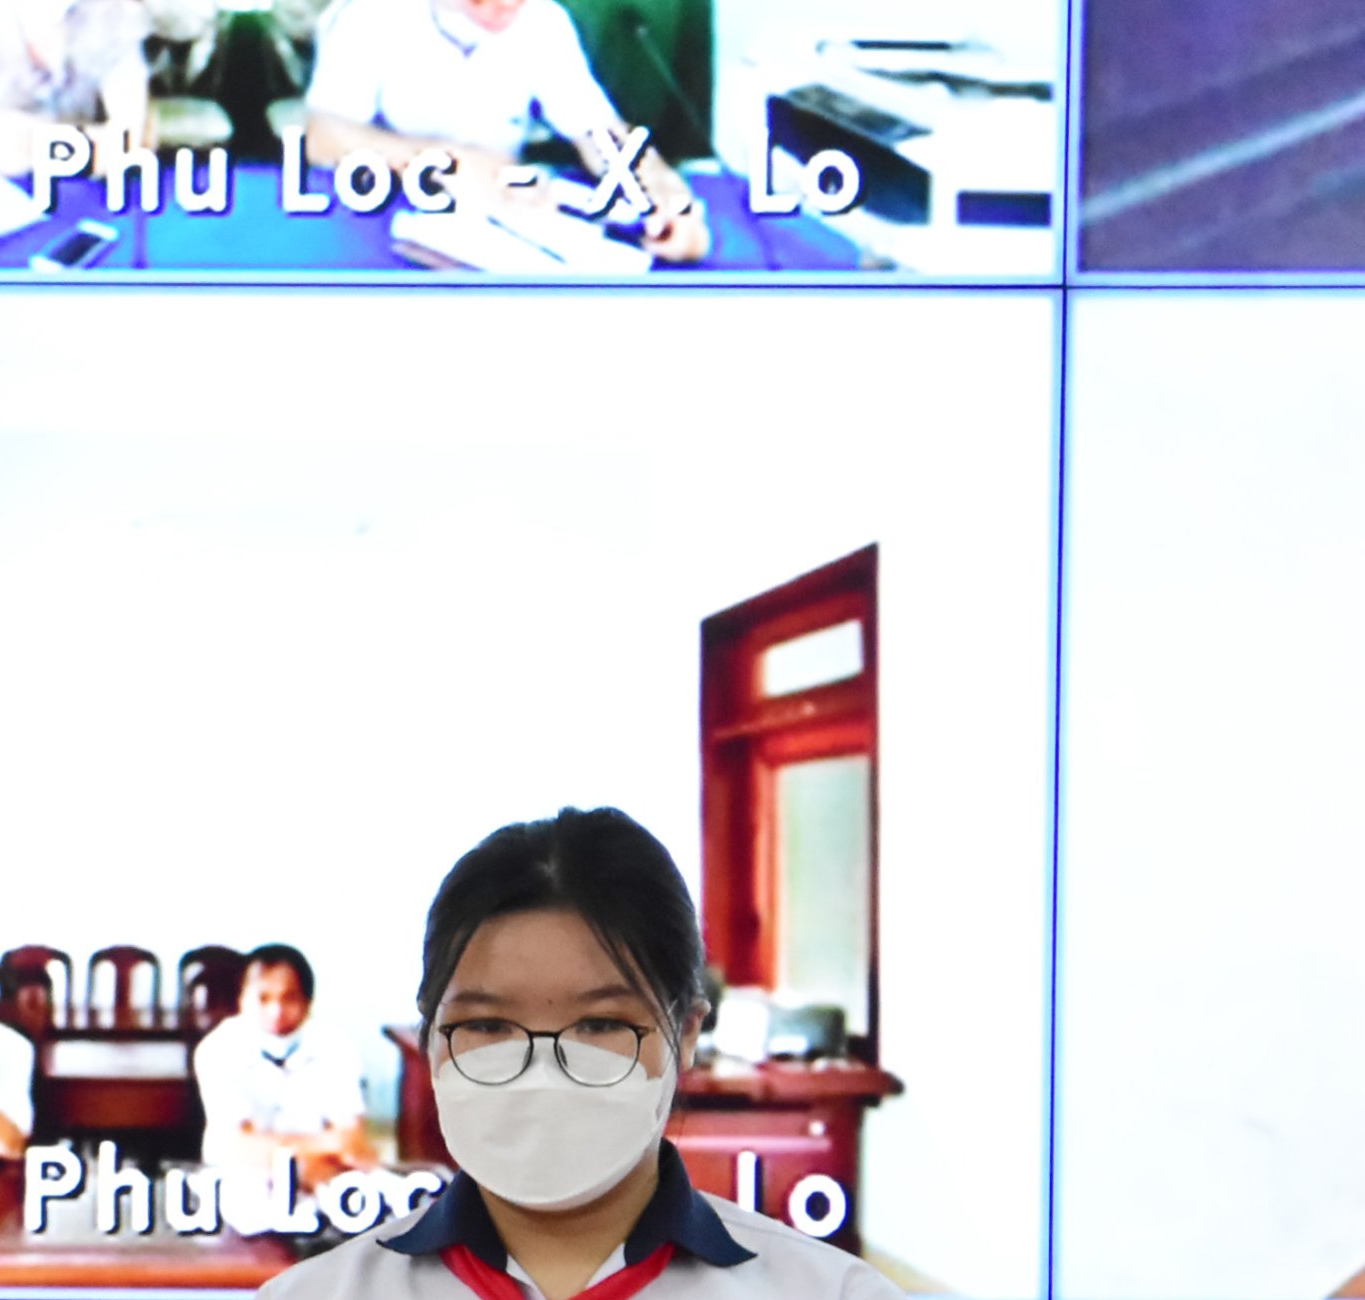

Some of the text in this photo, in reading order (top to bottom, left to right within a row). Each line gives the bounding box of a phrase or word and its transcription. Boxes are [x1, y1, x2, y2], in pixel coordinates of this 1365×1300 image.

[32, 122, 231, 214] Phu
[280, 124, 458, 214] Loc
[749, 127, 863, 214] Lo
[25, 1140, 224, 1236] Phu
